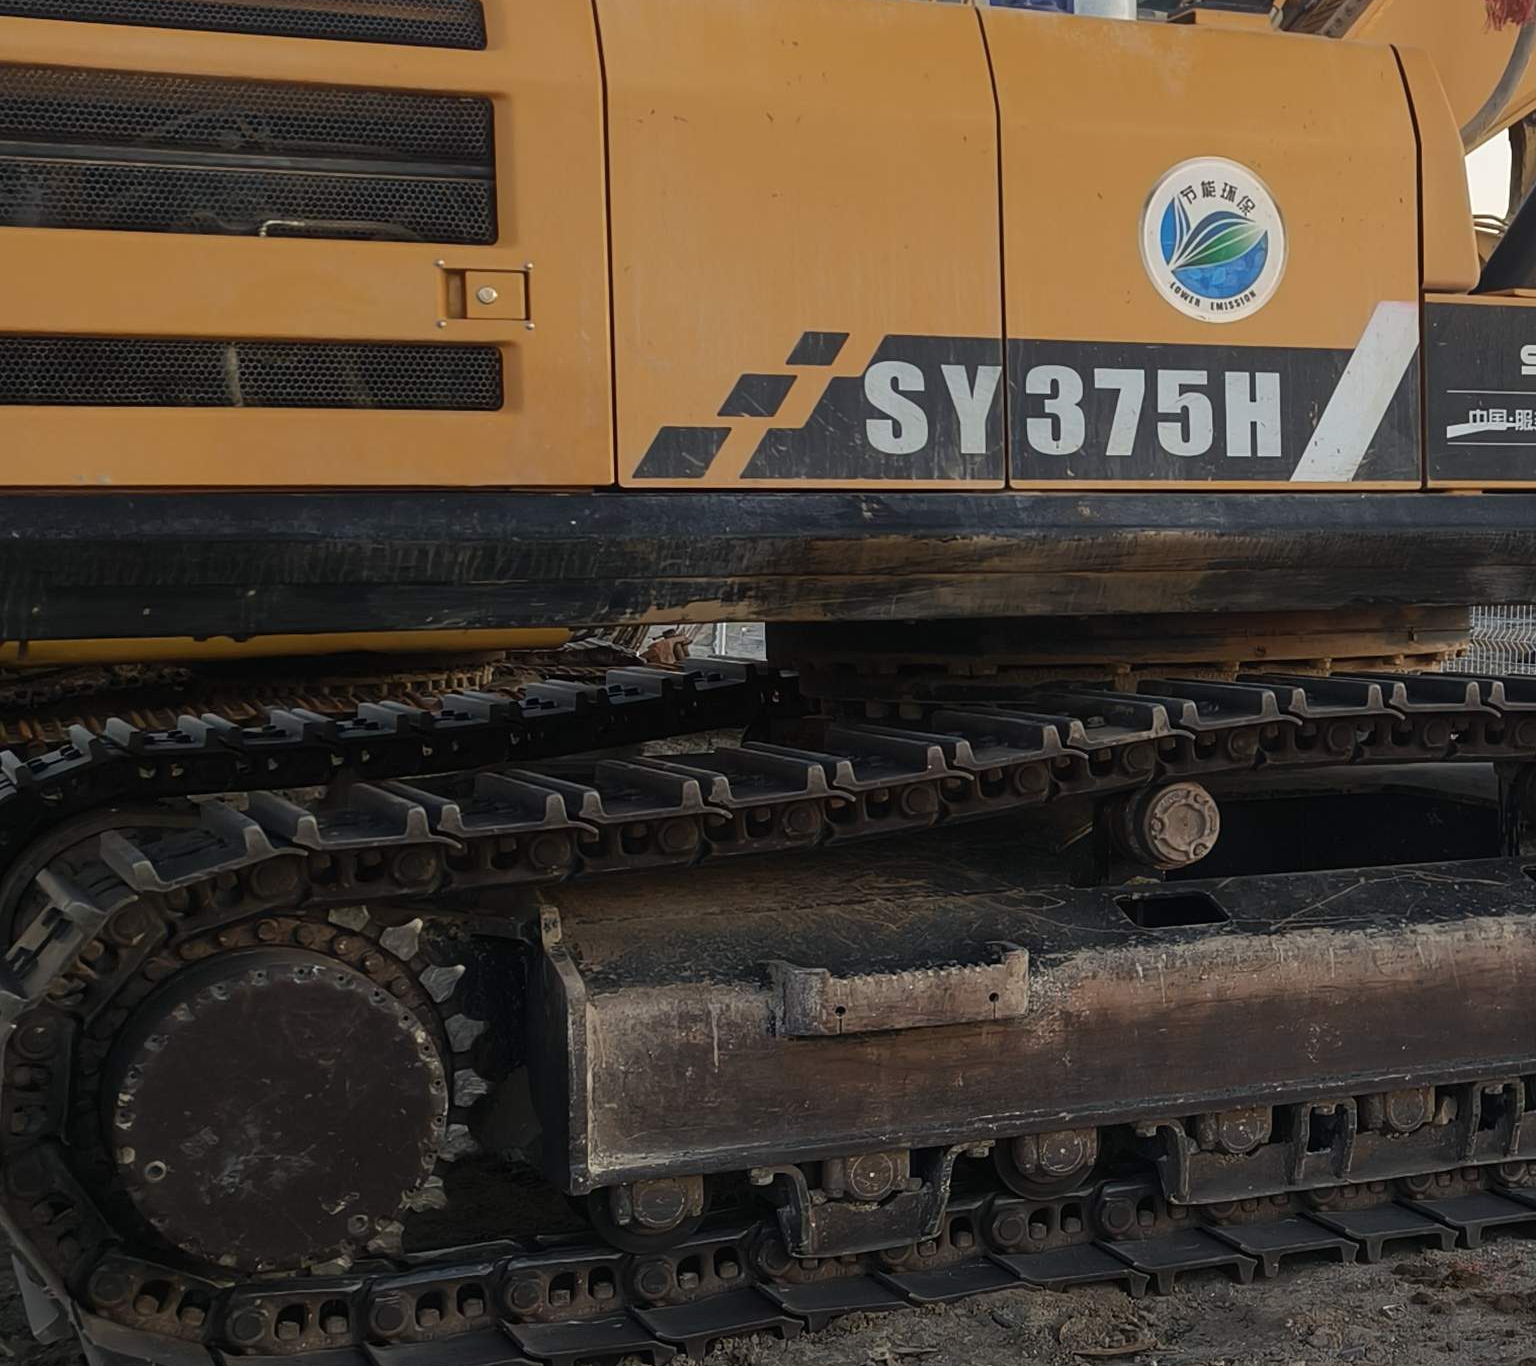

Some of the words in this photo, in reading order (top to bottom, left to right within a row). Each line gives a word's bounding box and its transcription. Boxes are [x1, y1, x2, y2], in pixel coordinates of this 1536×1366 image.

[1180, 180, 1256, 216] 节能环保
[1169, 282, 1201, 307] LOWER
[1210, 290, 1256, 311] EMISSION
